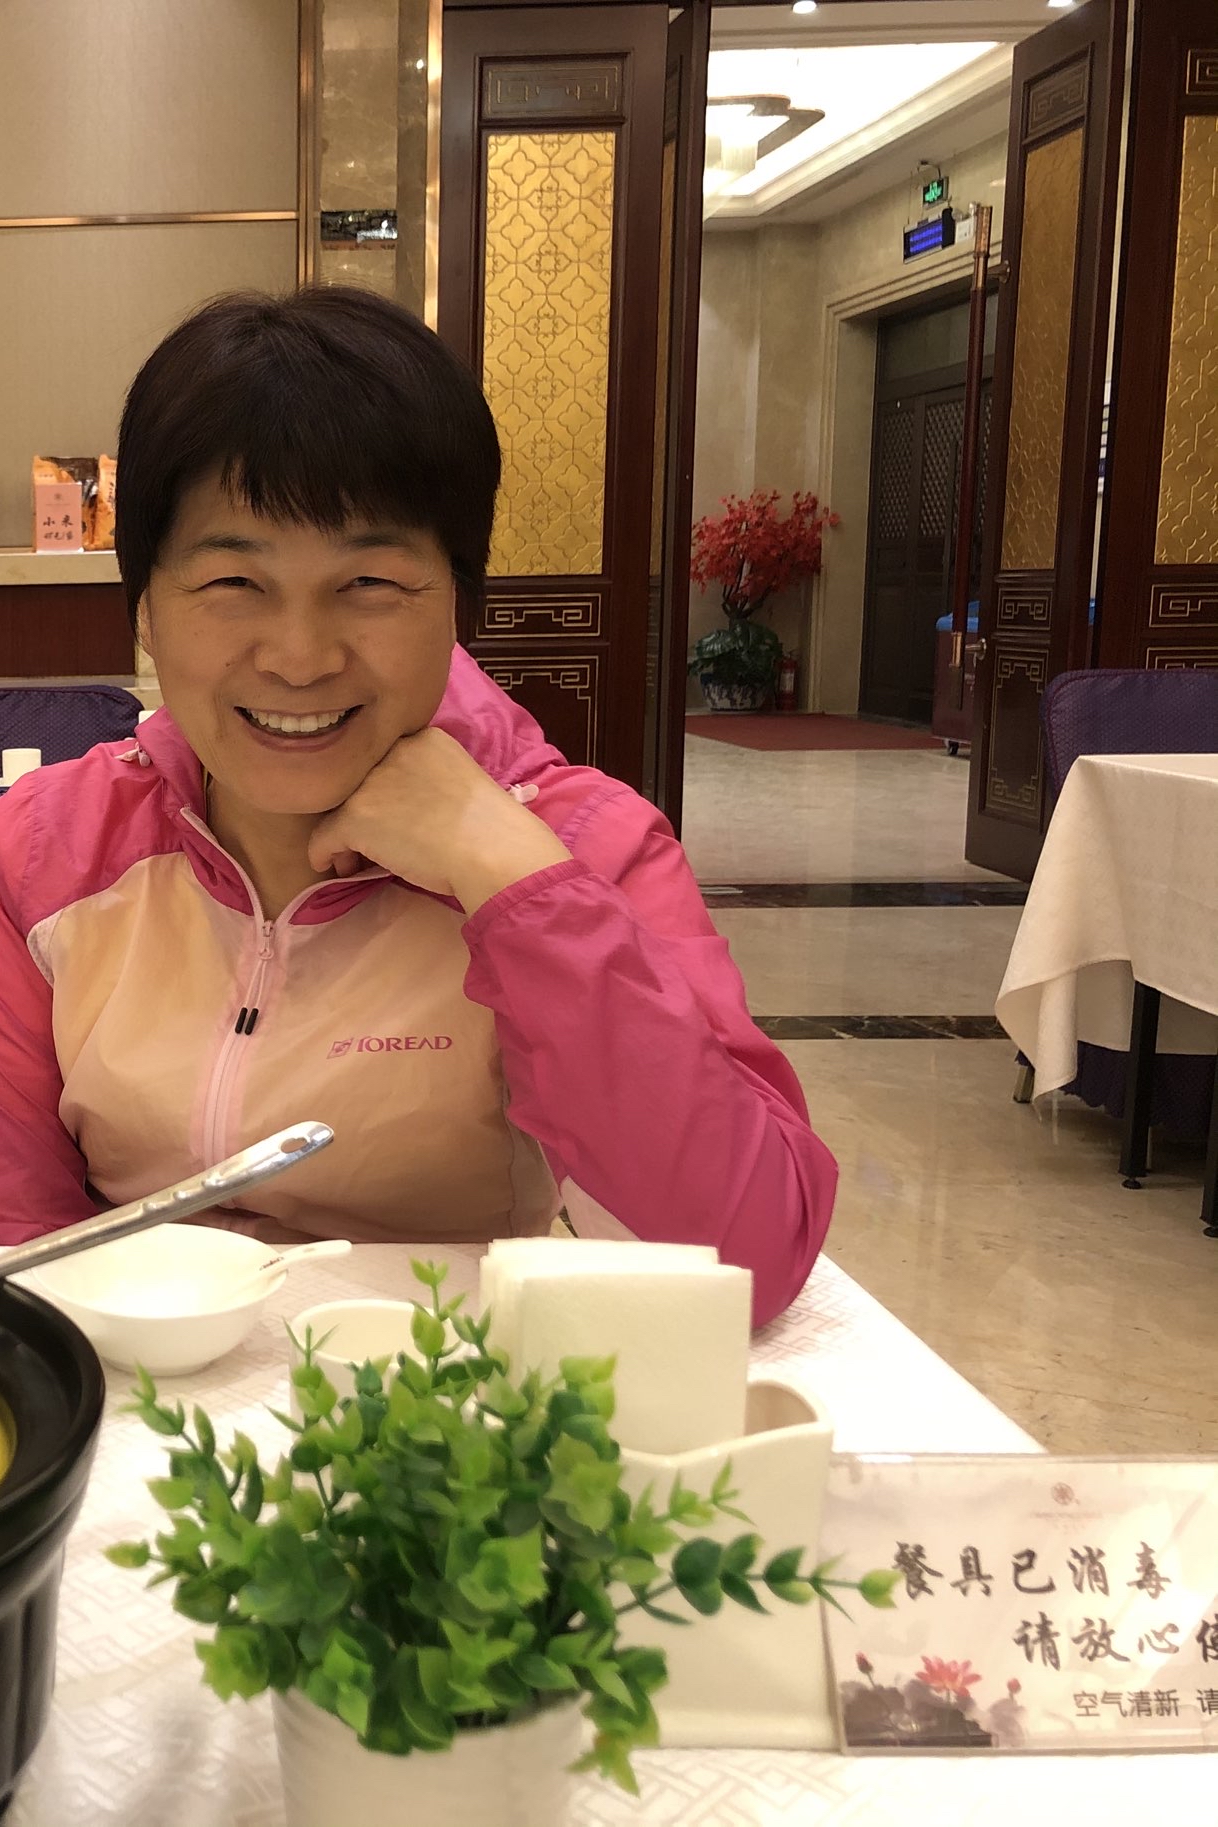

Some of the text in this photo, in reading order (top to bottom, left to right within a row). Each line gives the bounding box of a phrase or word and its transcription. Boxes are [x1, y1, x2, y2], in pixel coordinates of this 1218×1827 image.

[357, 1035, 453, 1053] TOREAD
[892, 1541, 1173, 1600] 餐具已消毒
[1073, 1689, 1180, 1717] 空气清新
